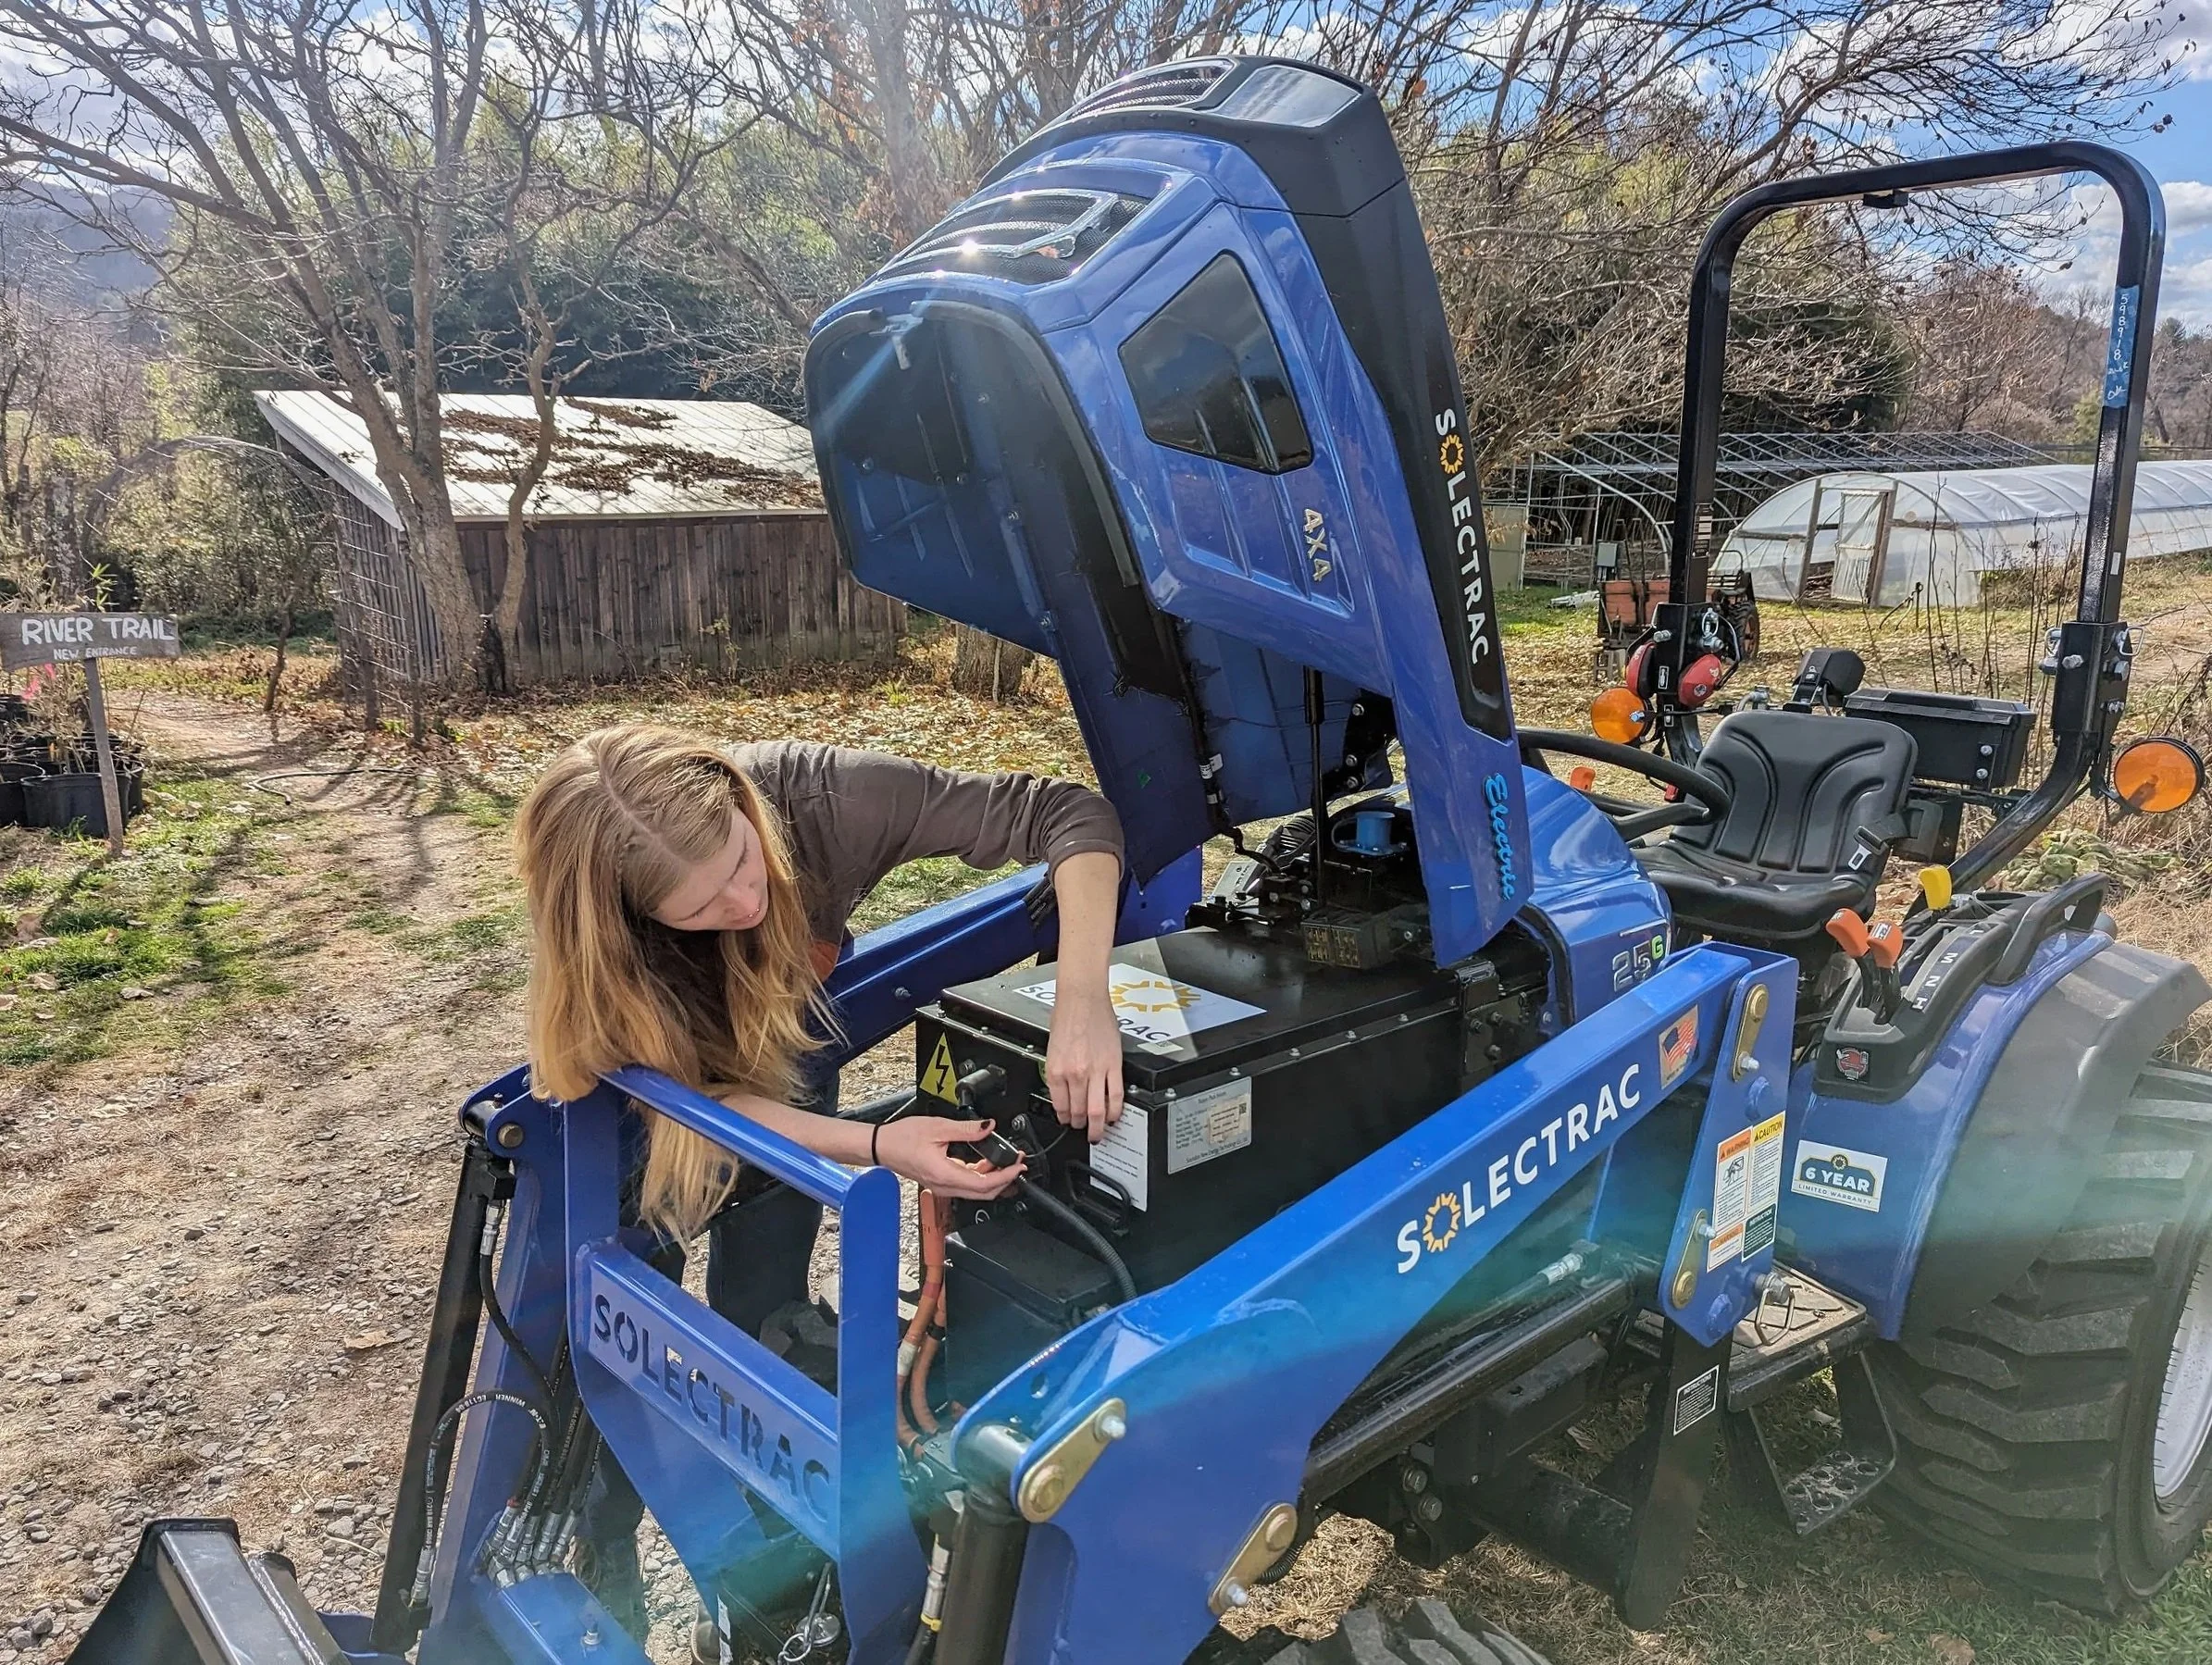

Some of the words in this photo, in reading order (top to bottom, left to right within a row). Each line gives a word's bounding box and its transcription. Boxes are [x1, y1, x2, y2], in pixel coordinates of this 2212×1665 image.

[1302, 508, 1332, 582] 4X4
[1435, 408, 1490, 665] SOLECTRAC
[21, 617, 93, 645] RIVER
[102, 617, 176, 640] TRAIL
[54, 649, 80, 660] NEW
[85, 646, 138, 658] ENTRANCE
[1485, 773, 1516, 901] Electric
[1758, 1121, 1783, 1139] CAUTION
[1397, 1063, 1641, 1274] SOLECTRAC
[1805, 1167, 1817, 1180] 6
[1821, 1170, 1870, 1193] YEAR
[1798, 1184, 1828, 1195] LIMITED
[1830, 1191, 1872, 1205] WARRANTY
[495, 1394, 526, 1408] WINNER
[593, 1293, 831, 1524] SOLECTRAC
